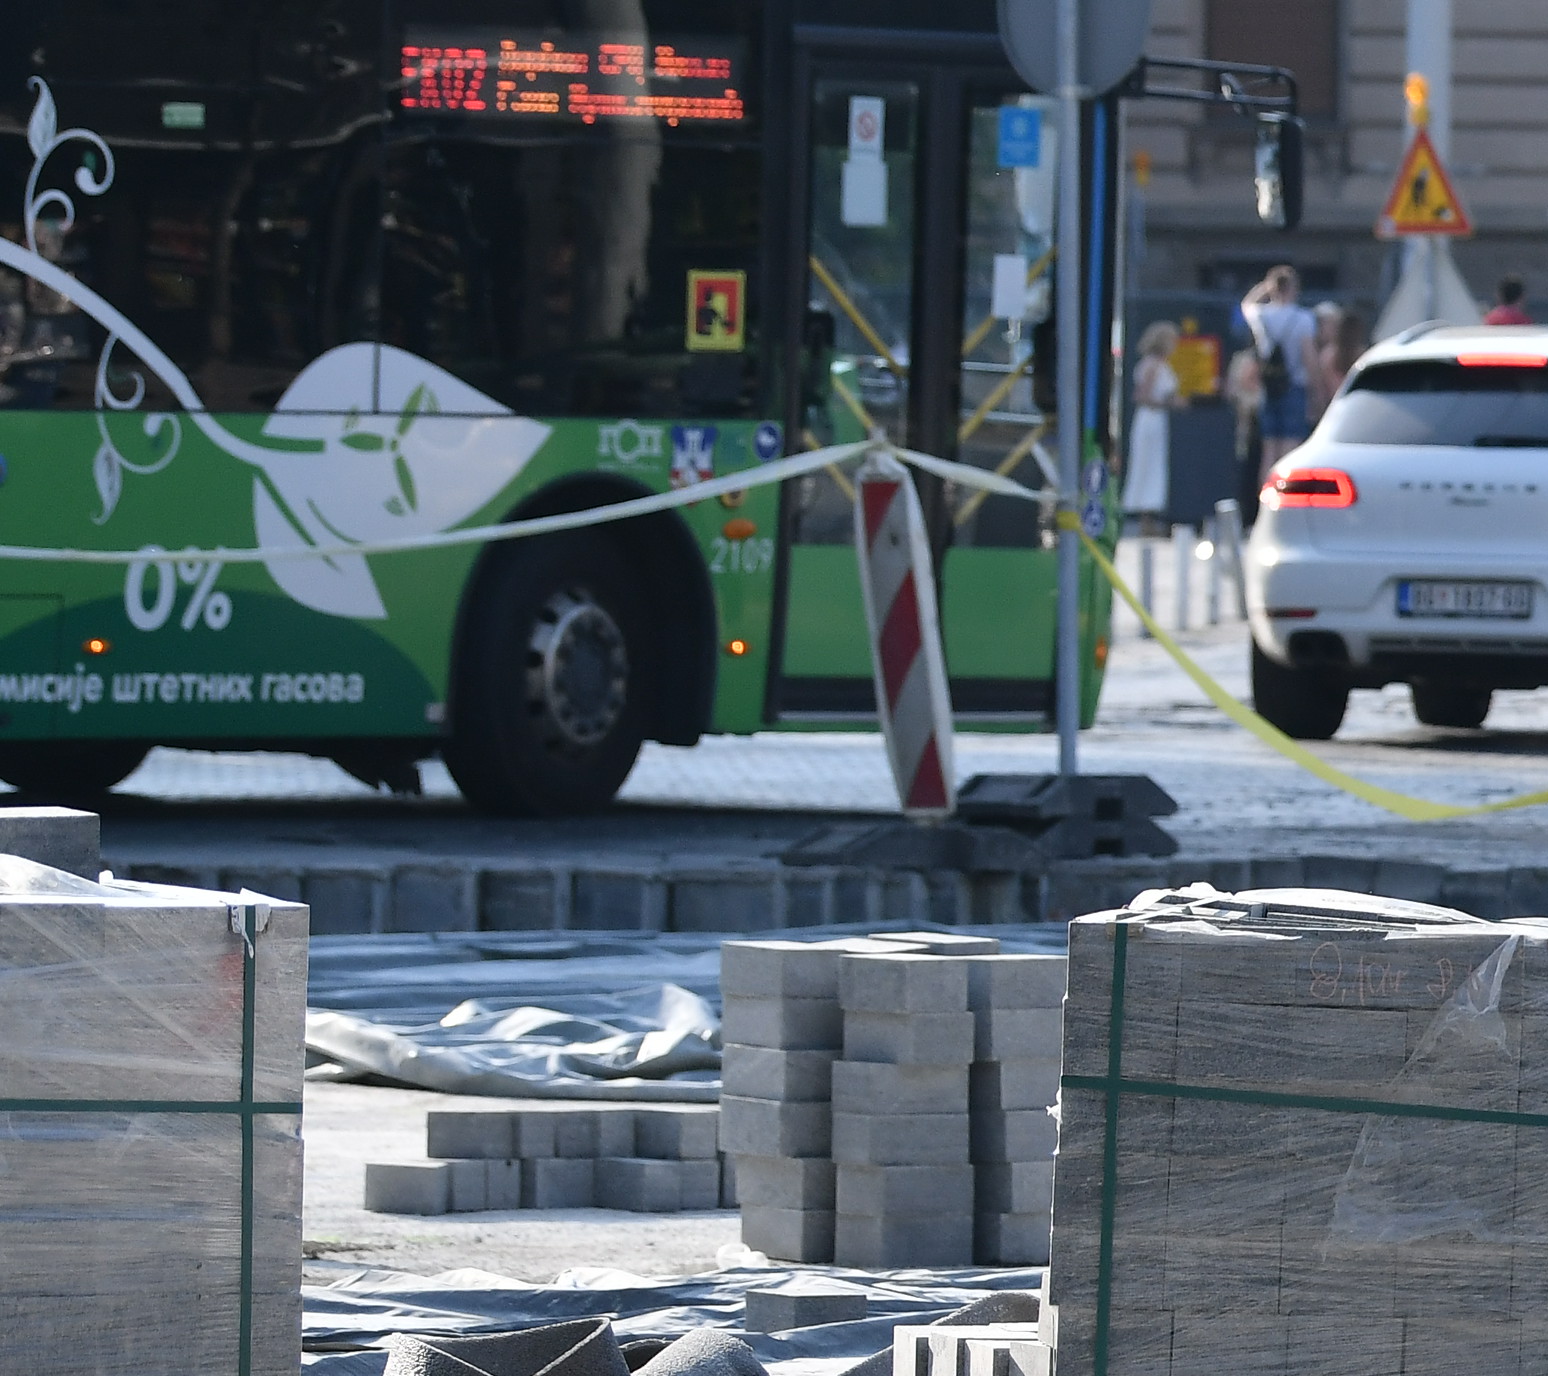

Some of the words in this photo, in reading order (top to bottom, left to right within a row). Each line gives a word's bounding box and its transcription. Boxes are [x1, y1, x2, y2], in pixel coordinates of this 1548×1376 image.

[710, 536, 774, 573] 2109
[125, 545, 232, 631] 0%
[0, 662, 103, 713] мисије
[112, 673, 253, 703] штетних
[261, 673, 365, 703] гасова
